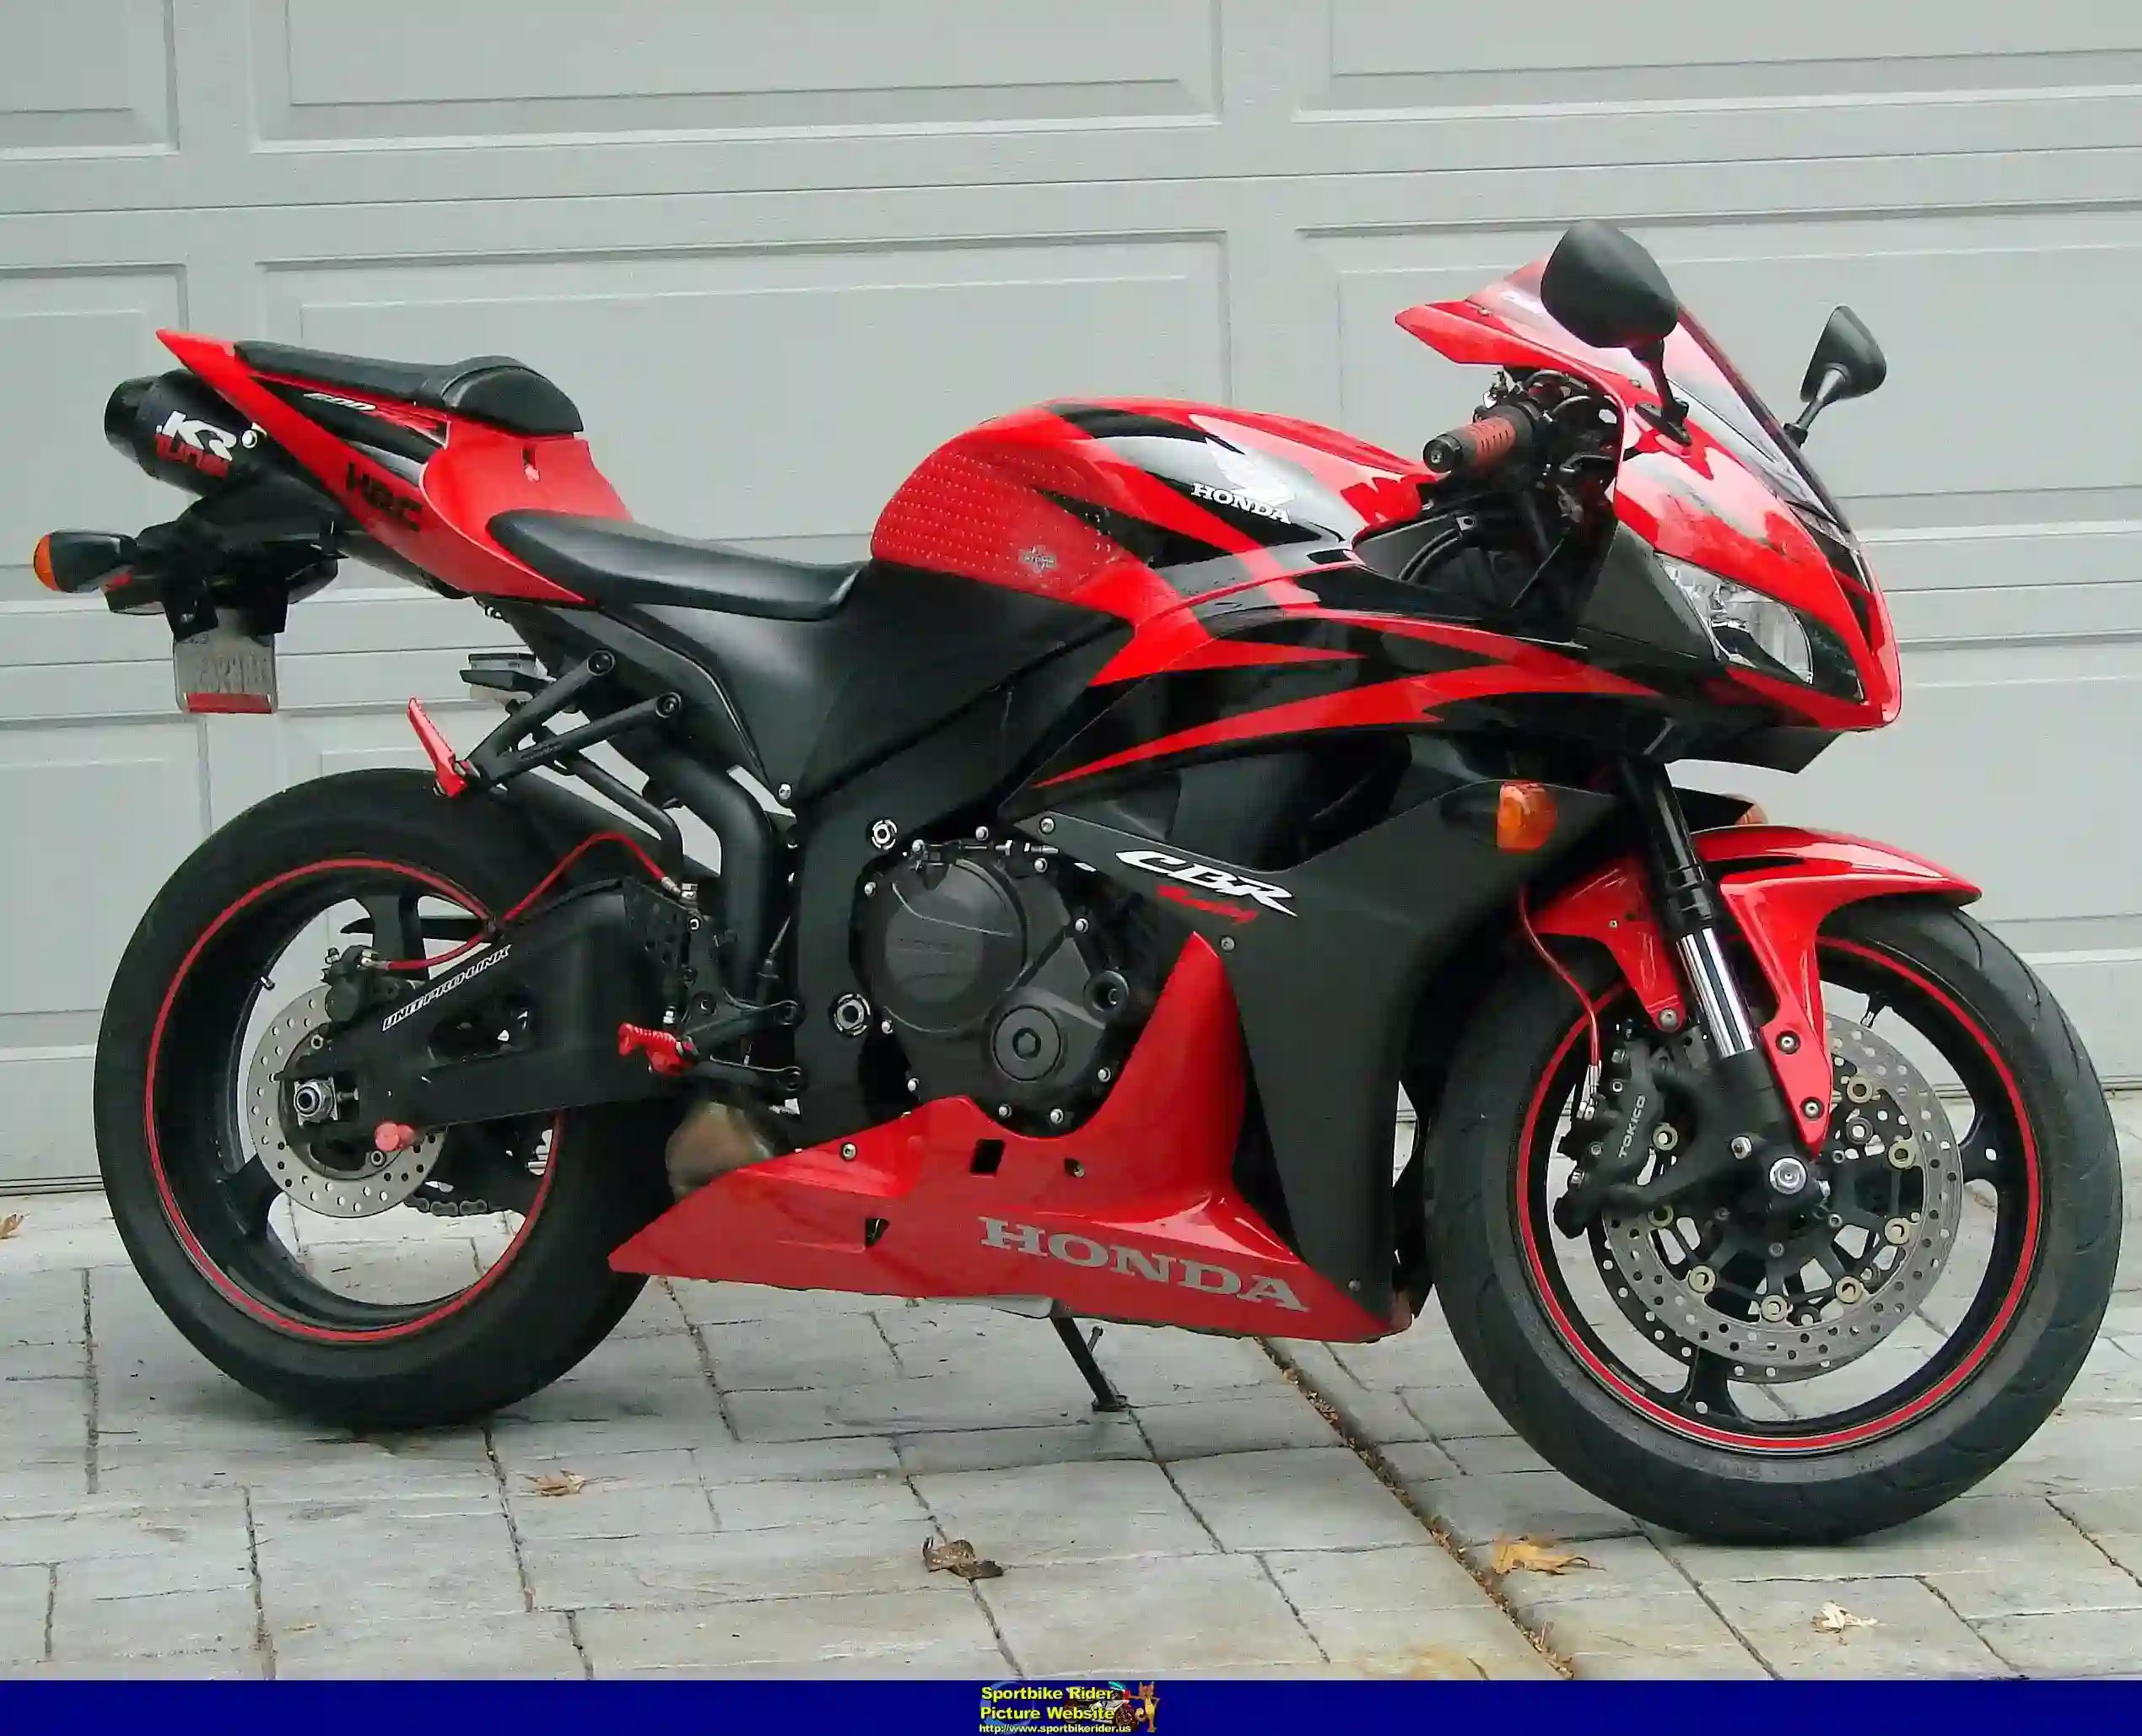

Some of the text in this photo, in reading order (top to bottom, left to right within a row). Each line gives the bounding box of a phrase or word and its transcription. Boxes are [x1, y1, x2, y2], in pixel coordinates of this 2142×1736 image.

[1190, 482, 1292, 525] HONDA
[1115, 850, 1298, 917] CBR
[1618, 1096, 1646, 1158] TOKICO
[978, 1216, 1310, 1313] HONDA
